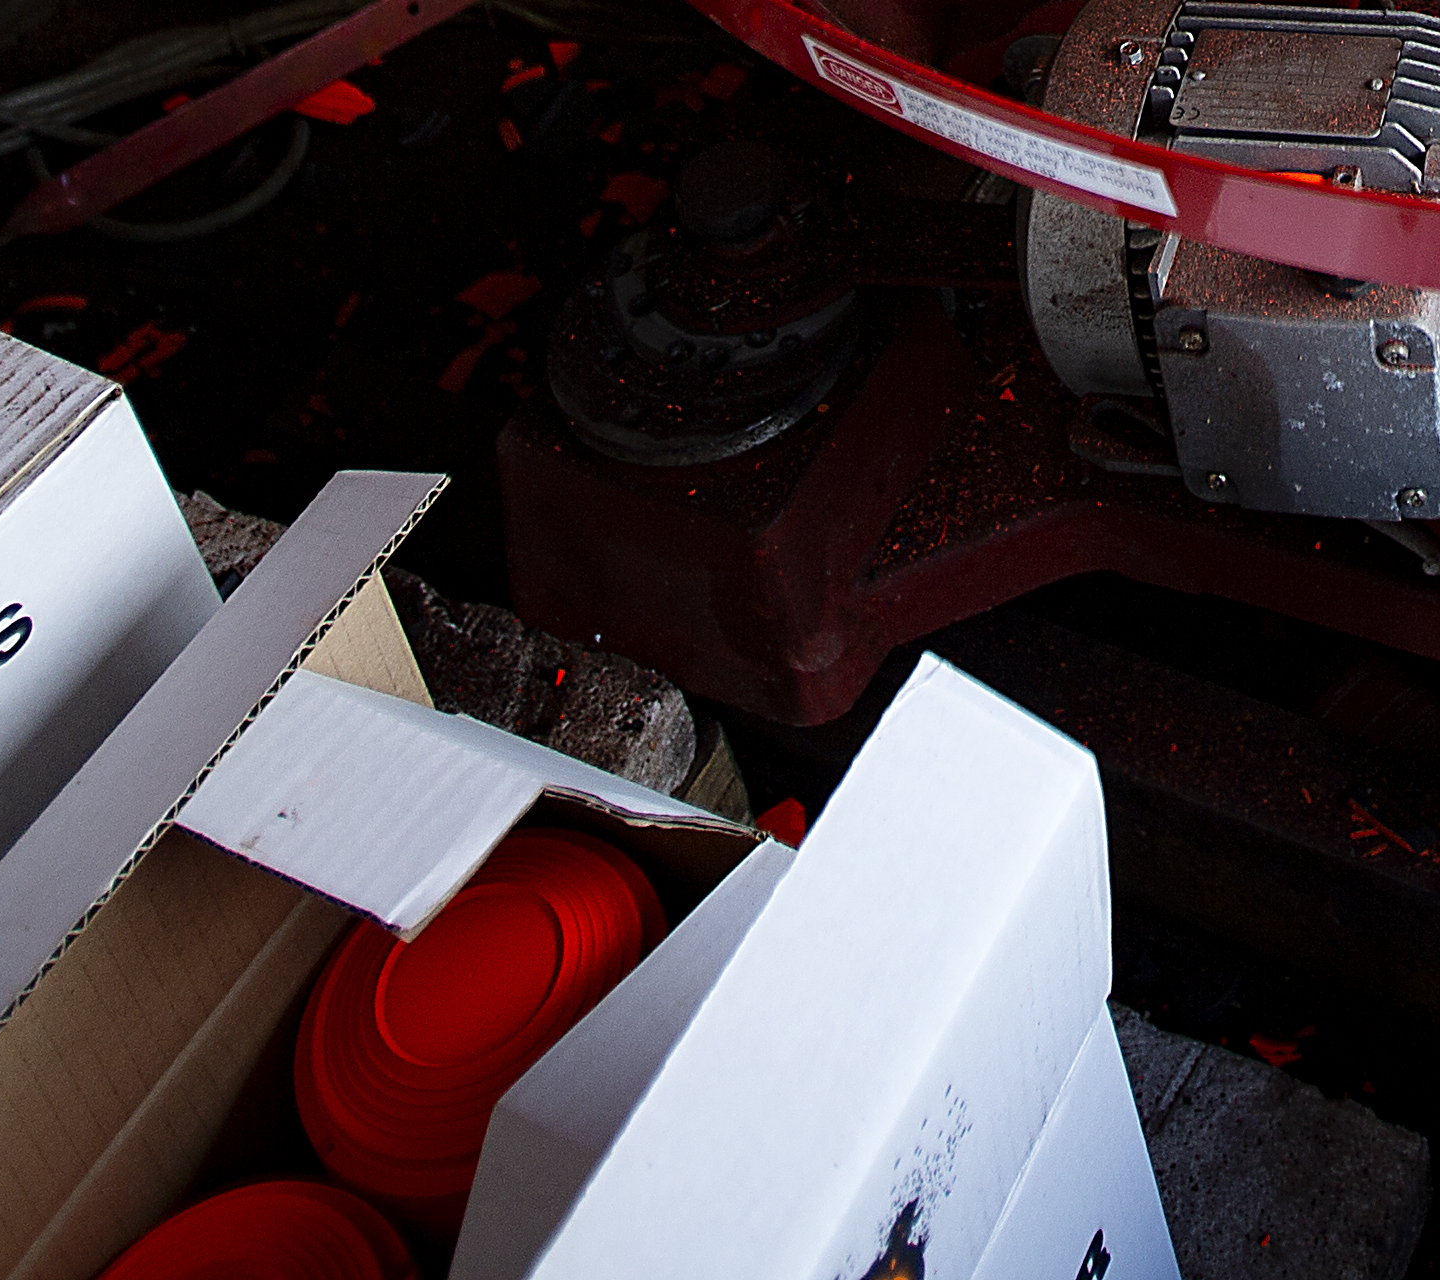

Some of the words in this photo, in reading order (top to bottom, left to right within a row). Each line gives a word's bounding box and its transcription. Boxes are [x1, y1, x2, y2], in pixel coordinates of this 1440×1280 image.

[829, 61, 886, 98] DANGER
[907, 102, 940, 122] avoid
[984, 133, 1019, 155] keep
[1024, 151, 1058, 170] away
[1062, 162, 1095, 179] from
[1101, 174, 1156, 200] moving
[948, 131, 972, 148] and
[975, 143, 1008, 161] front
[1010, 154, 1024, 167] of
[1029, 162, 1056, 178] trap
[951, 111, 972, 126] are
[974, 119, 1021, 144] thrown
[1027, 138, 1040, 149] at
[1043, 143, 1075, 163] high
[1133, 169, 1151, 186] To
